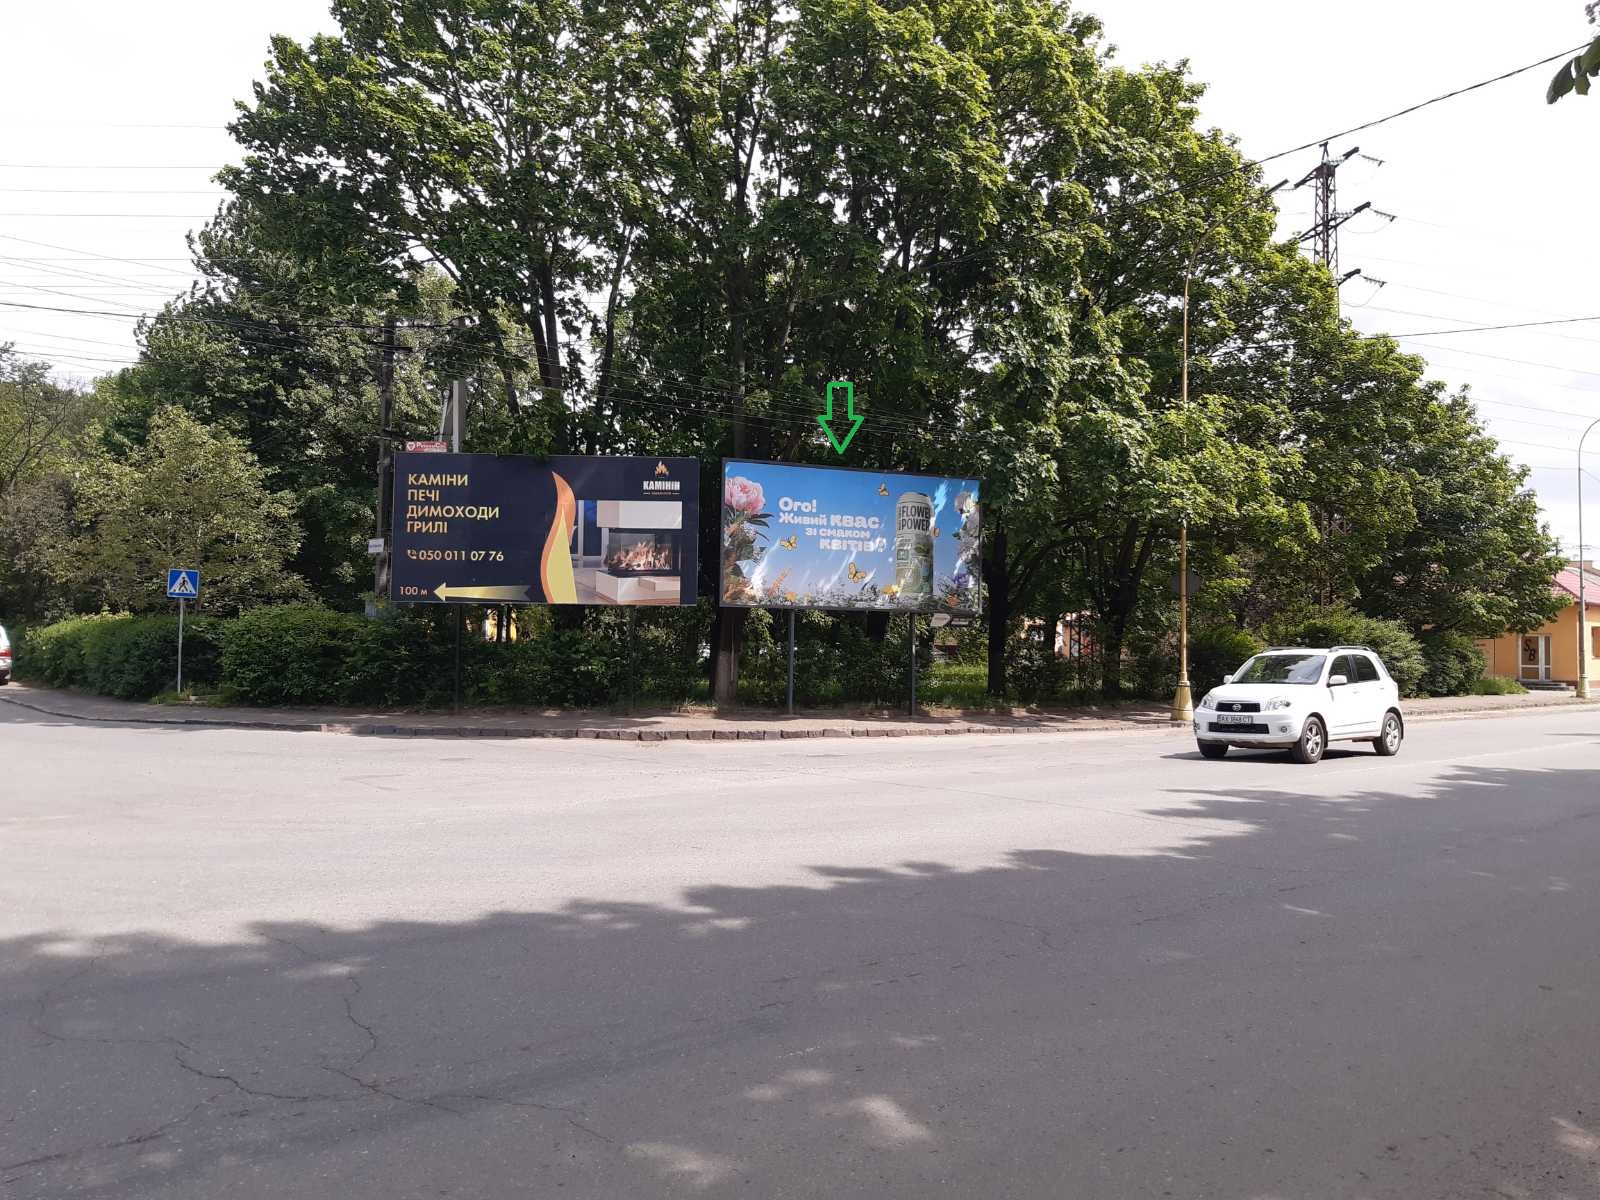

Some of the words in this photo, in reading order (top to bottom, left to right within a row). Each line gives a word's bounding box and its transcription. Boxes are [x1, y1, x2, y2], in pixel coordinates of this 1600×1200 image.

[408, 473, 469, 486] КАМІНИ
[407, 489, 440, 501] ПЕЧІ
[406, 505, 500, 520] ДИМОХОДИ
[779, 512, 827, 526] Живий
[901, 518, 931, 531] POWER
[406, 521, 448, 533] ГРИЛІ
[418, 550, 442, 561] 050
[444, 550, 466, 561] 011
[470, 551, 487, 561] 07
[489, 551, 504, 562] 76
[400, 586, 419, 596] 100
